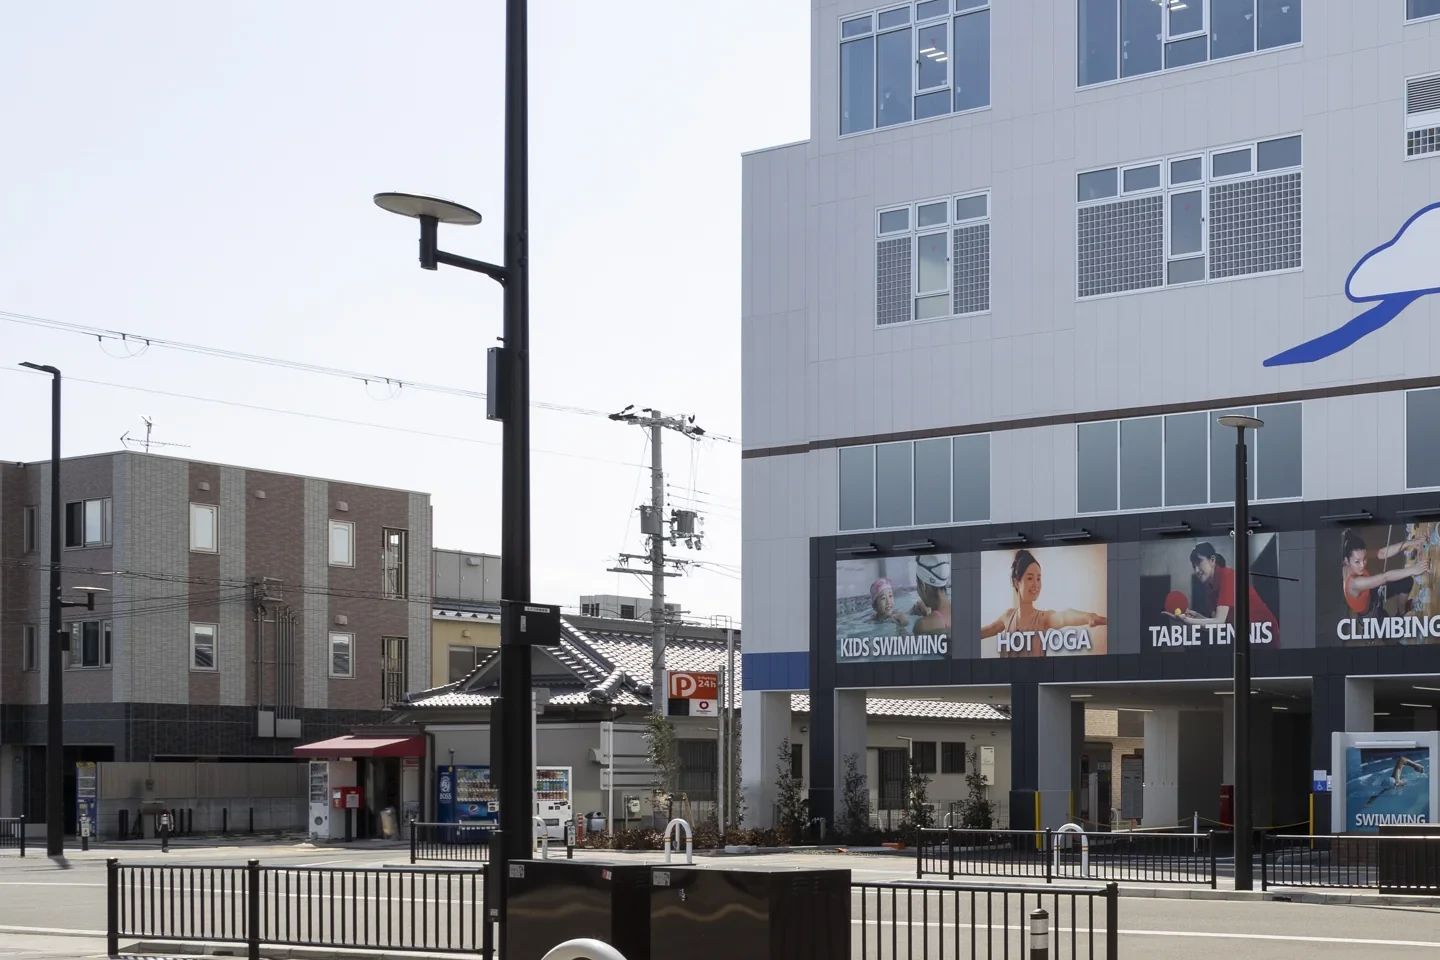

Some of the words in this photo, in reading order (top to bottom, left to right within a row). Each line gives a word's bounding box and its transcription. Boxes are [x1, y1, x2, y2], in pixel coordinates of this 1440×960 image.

[840, 637, 870, 657] KIDS
[872, 633, 948, 656] SWIMMING
[997, 631, 1035, 652] HOT
[1038, 628, 1092, 651] YOGA
[1149, 624, 1201, 647] TABLE
[697, 679, 717, 689] 24h
[1355, 813, 1426, 826] SWIMMING
